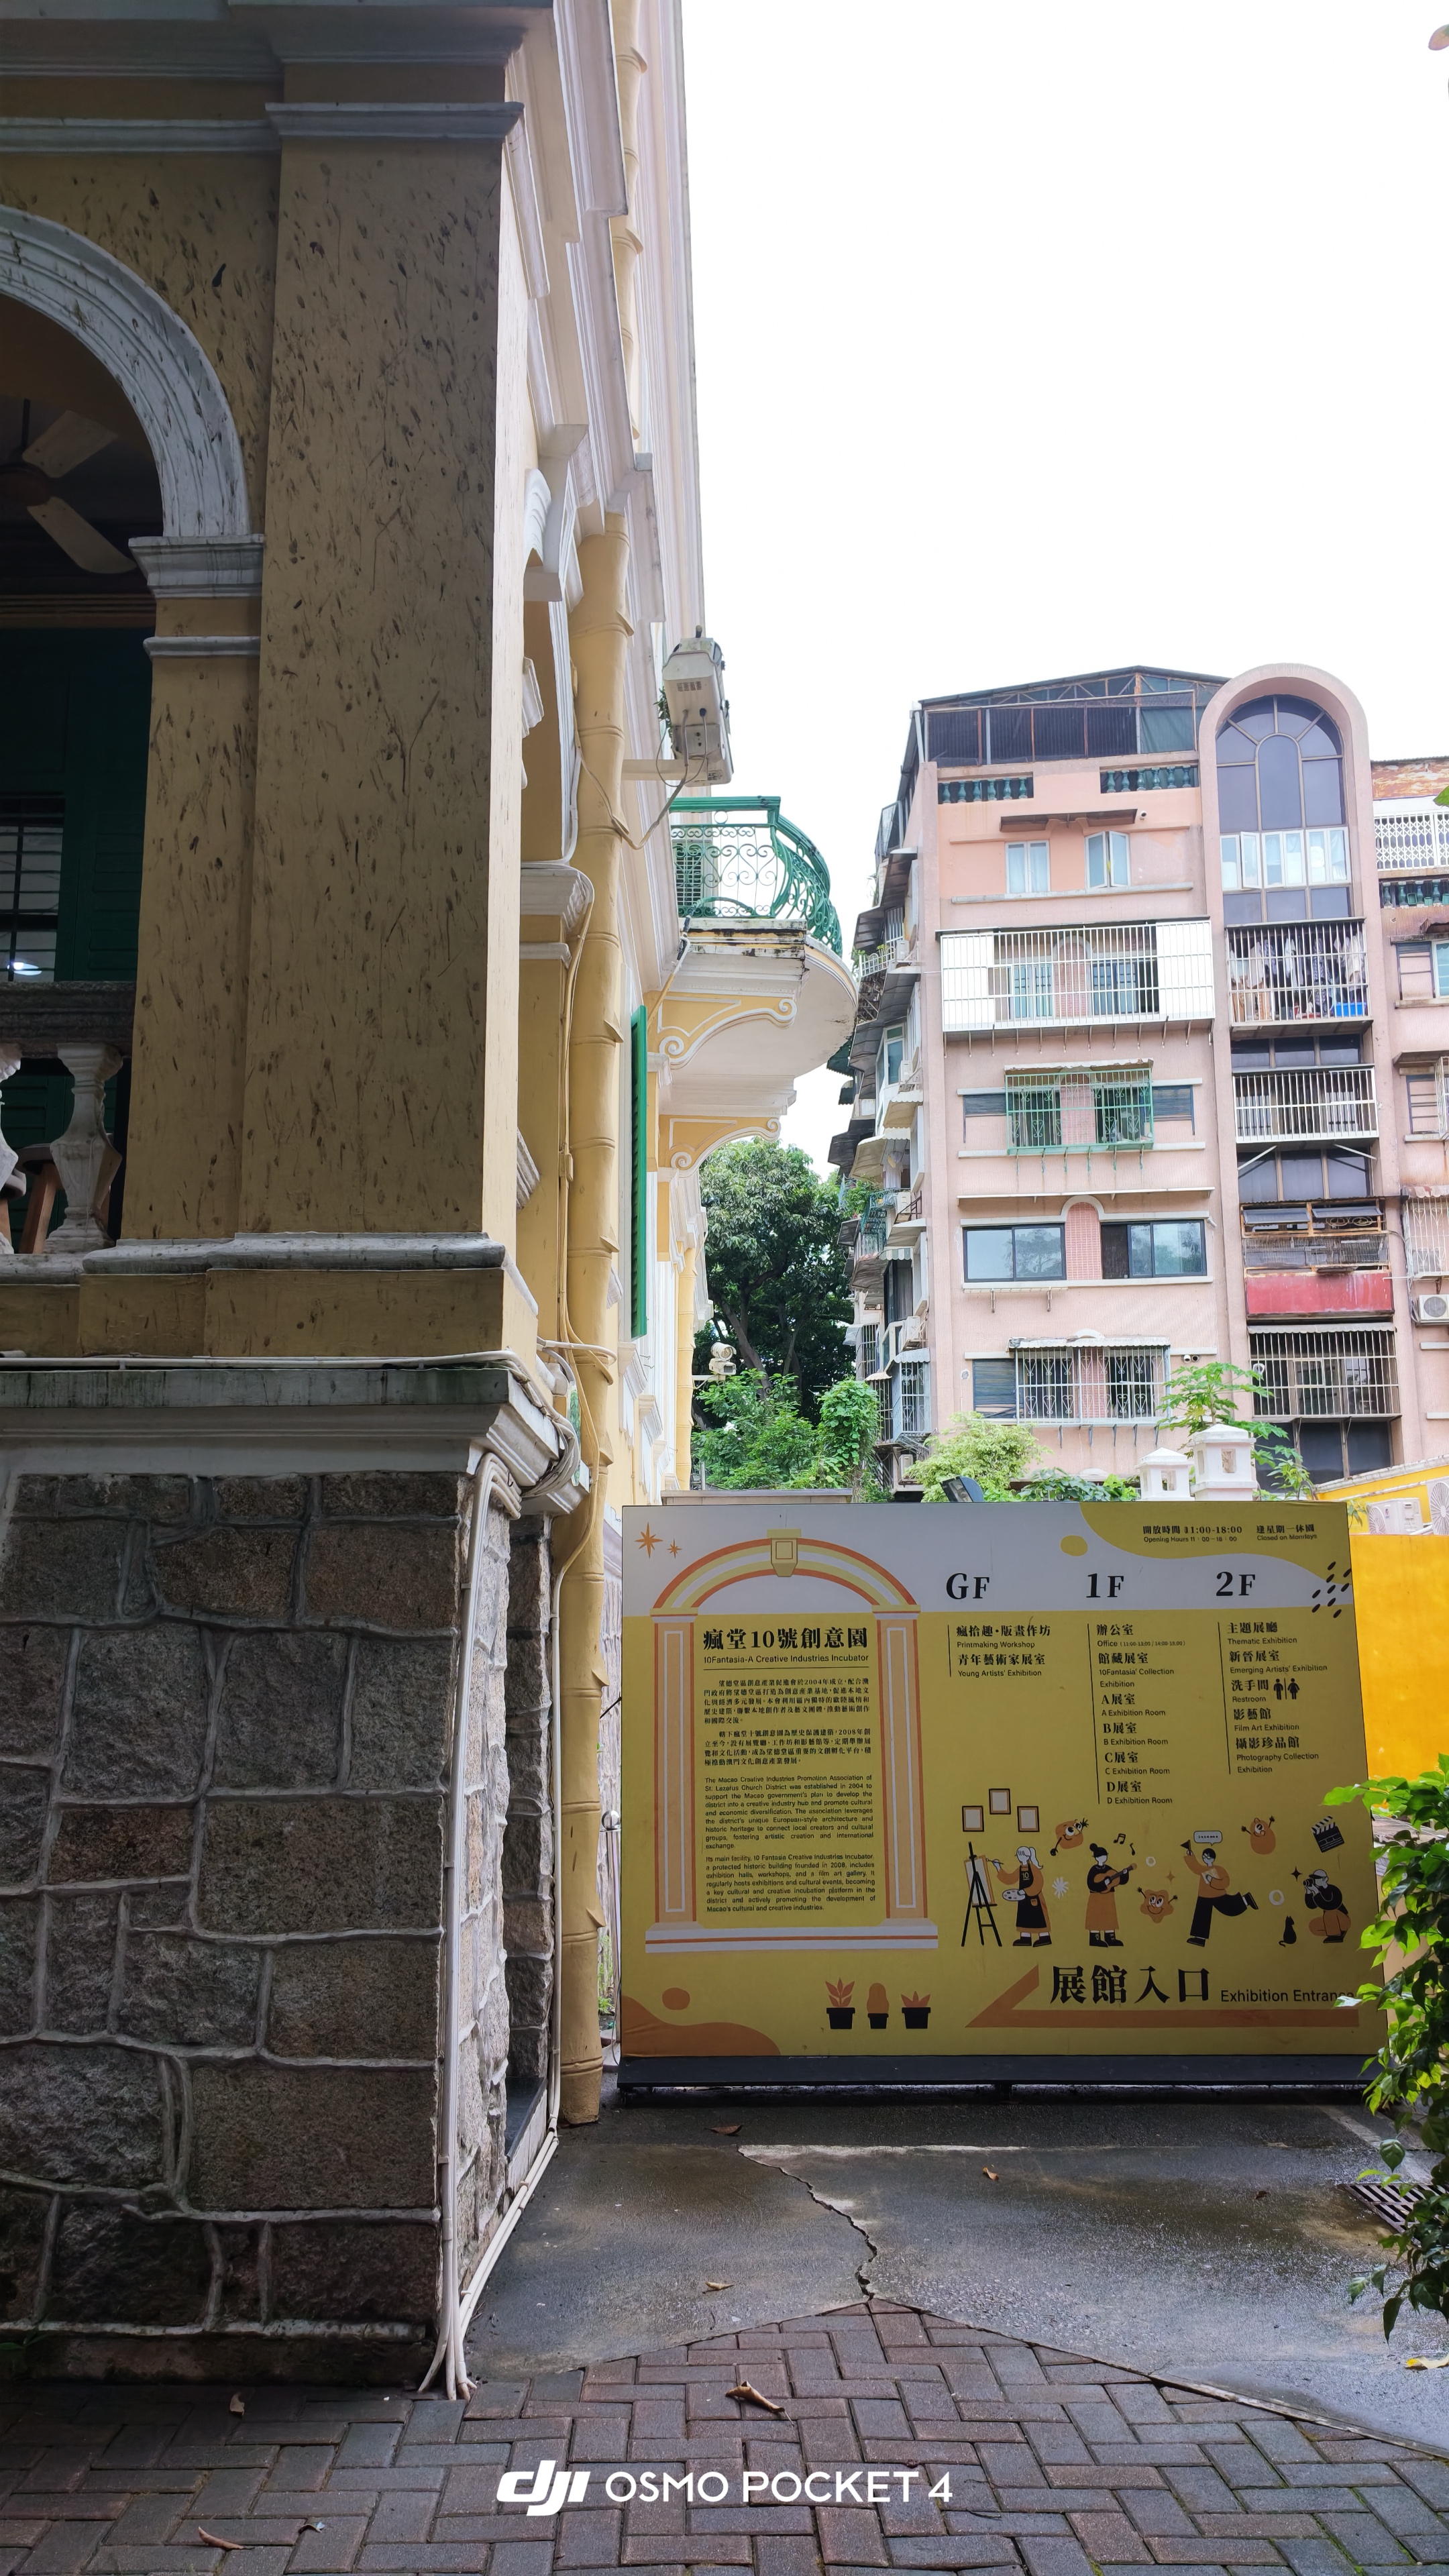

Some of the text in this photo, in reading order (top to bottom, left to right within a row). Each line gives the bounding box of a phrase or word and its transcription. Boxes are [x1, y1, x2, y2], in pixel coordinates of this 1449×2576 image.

[945, 1572, 990, 1600] GF
[1086, 1572, 1124, 1599] 1F
[1215, 1571, 1256, 1597] 2F
[1095, 1623, 1134, 1636] 辦公室
[1227, 1621, 1278, 1633] 主題展廳
[702, 1626, 867, 1650] 瘋堂10號創意園
[1262, 1636, 1297, 1644] Exhibition
[957, 1641, 1035, 1650] Printmaking Workshop
[704, 1653, 869, 1664] 10Fantasia-A Creative Industries Incubator
[957, 1652, 1045, 1666] 青年藝術家展室
[1097, 1652, 1148, 1665] 館藏展室
[1229, 1649, 1280, 1663] 新晉展室
[957, 1670, 980, 1678] Young
[1230, 1666, 1264, 1675] Emerging
[1292, 1664, 1328, 1672] Exhibition
[1099, 1680, 1135, 1688] Exhibition
[1230, 1678, 1269, 1692] 洗手間
[1101, 1693, 1136, 1705] A展室
[1108, 1709, 1143, 1717] Exhibition
[1233, 1707, 1271, 1721] 影藝館
[1102, 1721, 1137, 1734] B展室
[1264, 1723, 1299, 1731] Exhibition
[1110, 1737, 1146, 1746] Exhibition
[1235, 1735, 1299, 1750] 攝影珍品館
[1104, 1751, 1138, 1764] C展室
[1236, 1752, 1319, 1762] Photography Collection
[1104, 1767, 1111, 1775] C
[1112, 1767, 1148, 1775] Exhibition
[1237, 1765, 1273, 1774] Exhibition
[1106, 1780, 1142, 1793] D展室
[1106, 1796, 1113, 1805] D
[1114, 1796, 1150, 1805] Exhibition
[1050, 1964, 1210, 2004] 展館入口
[1220, 1988, 1289, 2002] Exhibition
